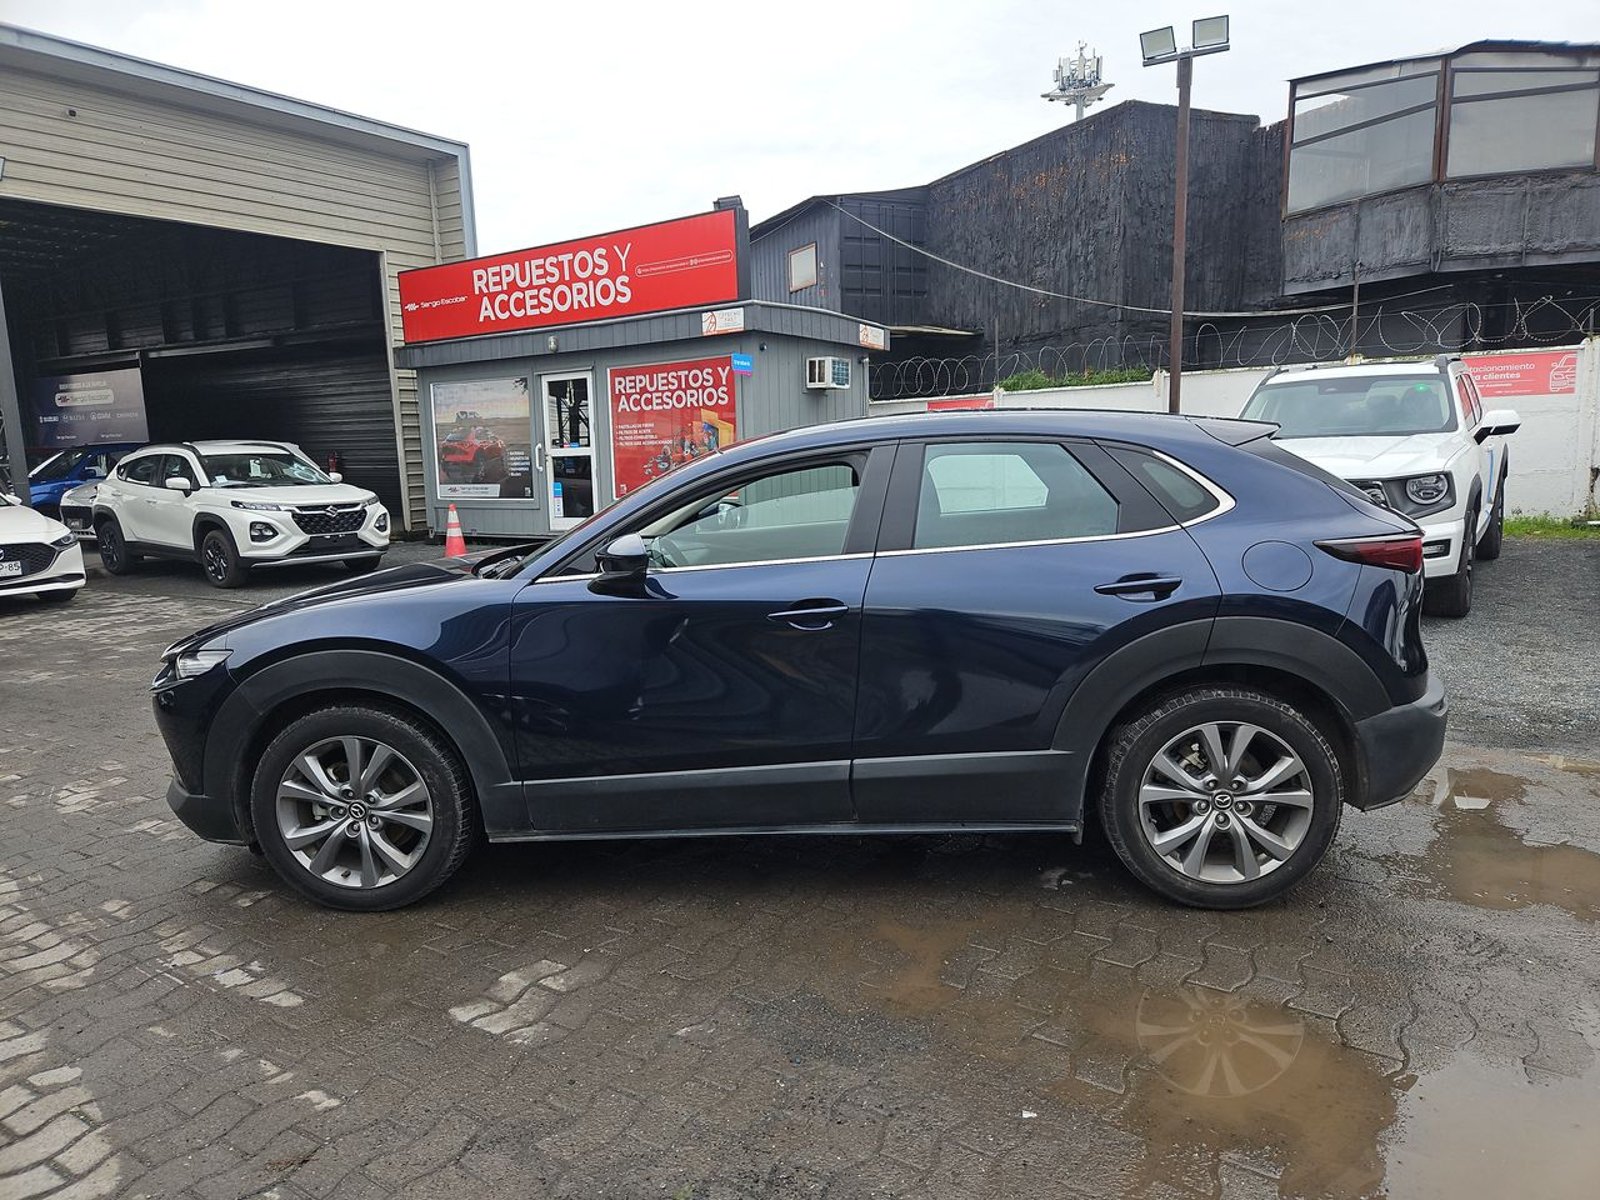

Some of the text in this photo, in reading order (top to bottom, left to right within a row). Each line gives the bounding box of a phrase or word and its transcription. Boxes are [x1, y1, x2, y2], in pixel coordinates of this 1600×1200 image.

[473, 247, 609, 295] REPUESTOS
[613, 243, 631, 272] Y
[440, 295, 468, 305] Escobar
[479, 275, 632, 322] ACCESORIOS
[614, 366, 731, 395] REPUESTOS Y
[1469, 363, 1536, 373] tacionamiento
[1483, 372, 1521, 381] clientes
[617, 386, 729, 413] ACCESORIOS
